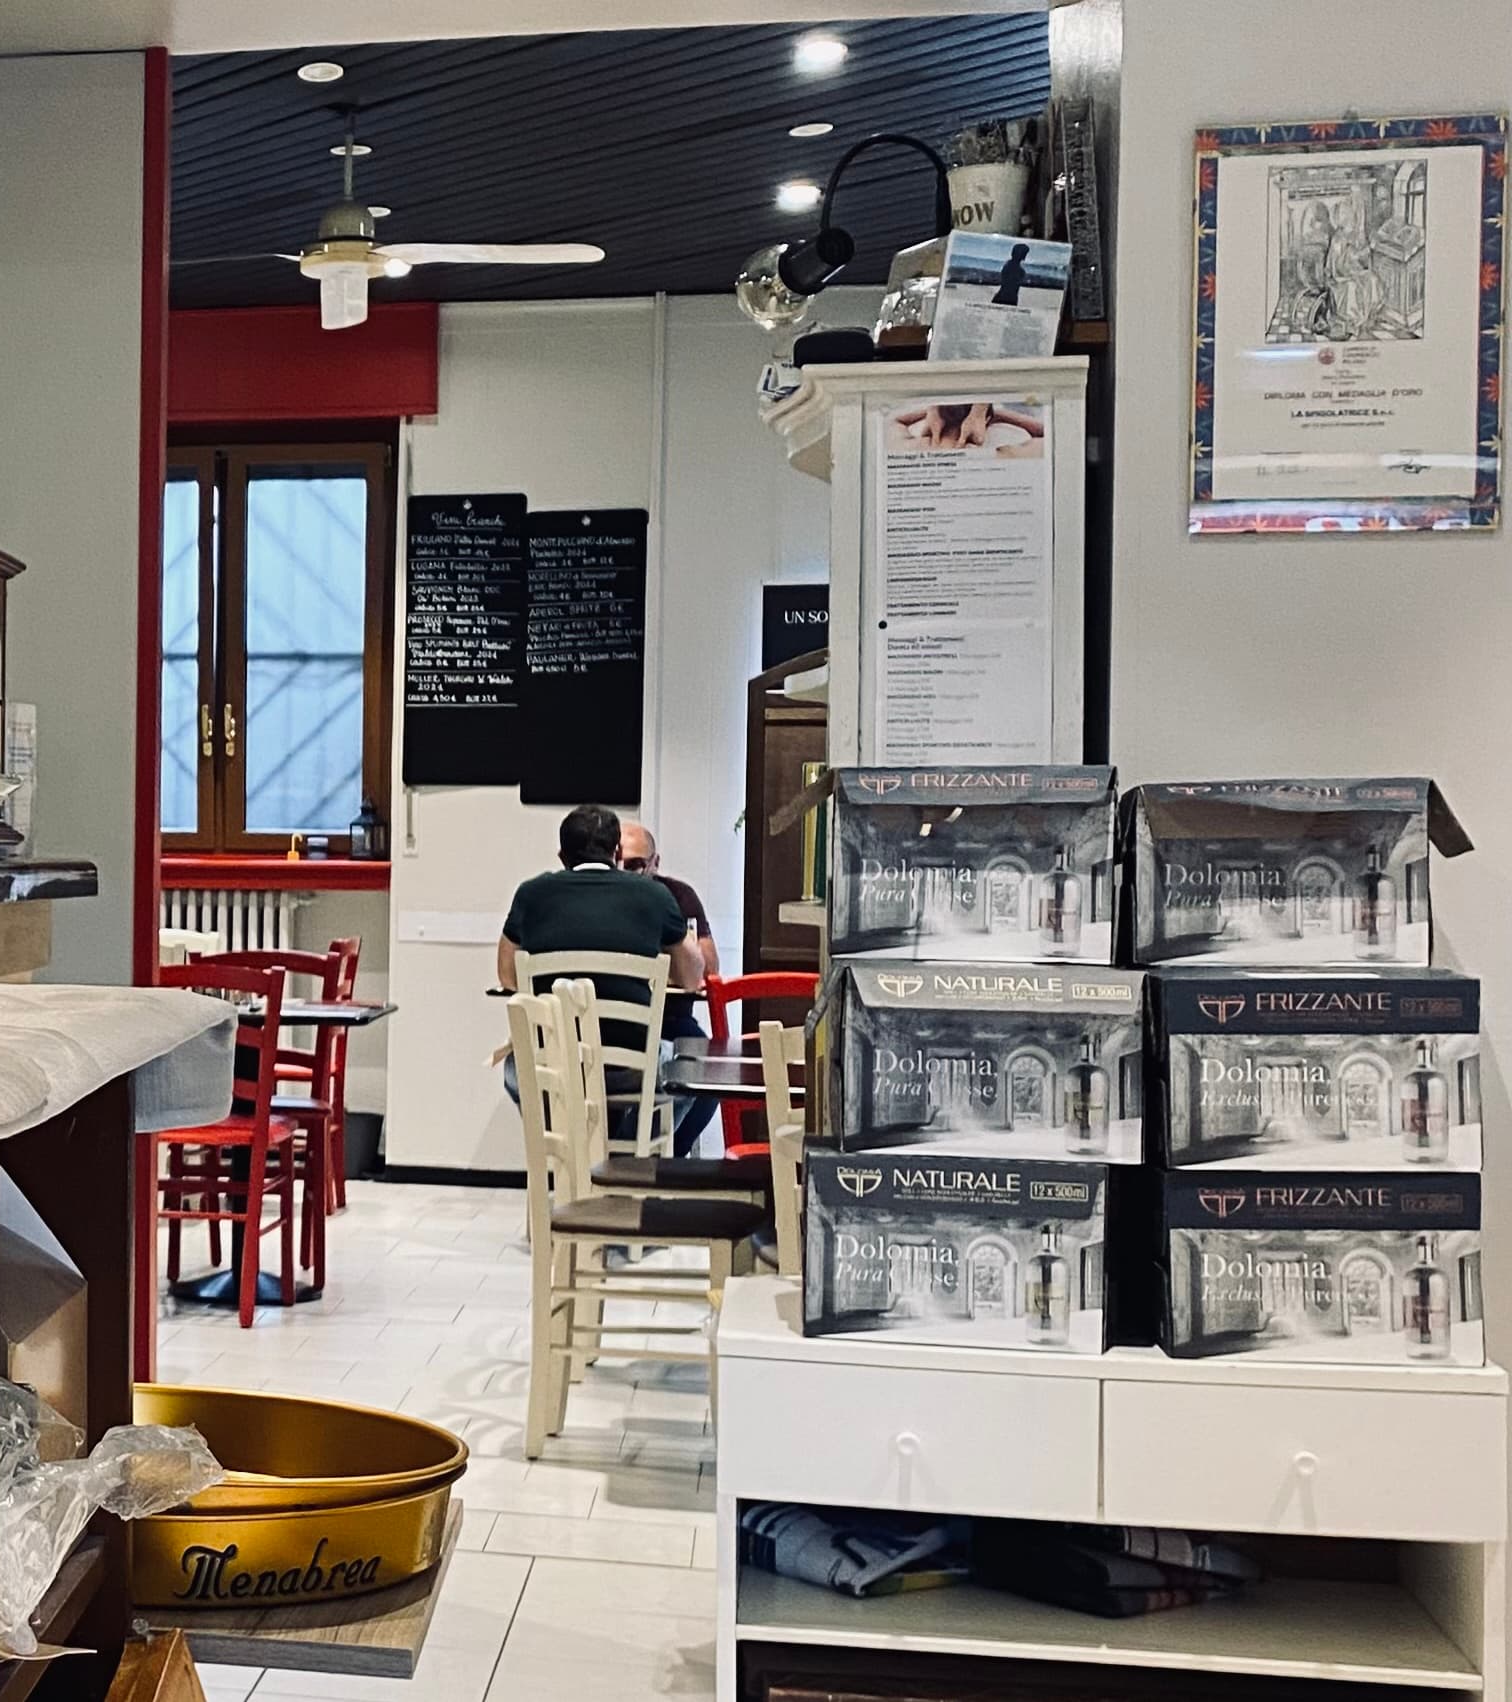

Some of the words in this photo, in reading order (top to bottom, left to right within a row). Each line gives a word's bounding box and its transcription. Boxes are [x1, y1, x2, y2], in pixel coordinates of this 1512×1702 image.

[784, 610, 805, 624] UN
[911, 773, 1033, 788] FRIZZANTE
[859, 883, 906, 902] Pura
[934, 974, 1063, 993] NATURALE
[1074, 985, 1088, 997] 12
[1098, 986, 1129, 998] 500ml
[1256, 992, 1392, 1011] FRIZZANTE
[872, 1077, 922, 1097] Pura
[893, 1168, 1022, 1193] NATURALE
[1033, 1183, 1046, 1198] 12
[1055, 1184, 1085, 1199] 500ml
[1256, 1187, 1392, 1207] FRIZZANTE
[835, 1263, 883, 1283] Pura
[173, 1536, 383, 1600] Menabrea
